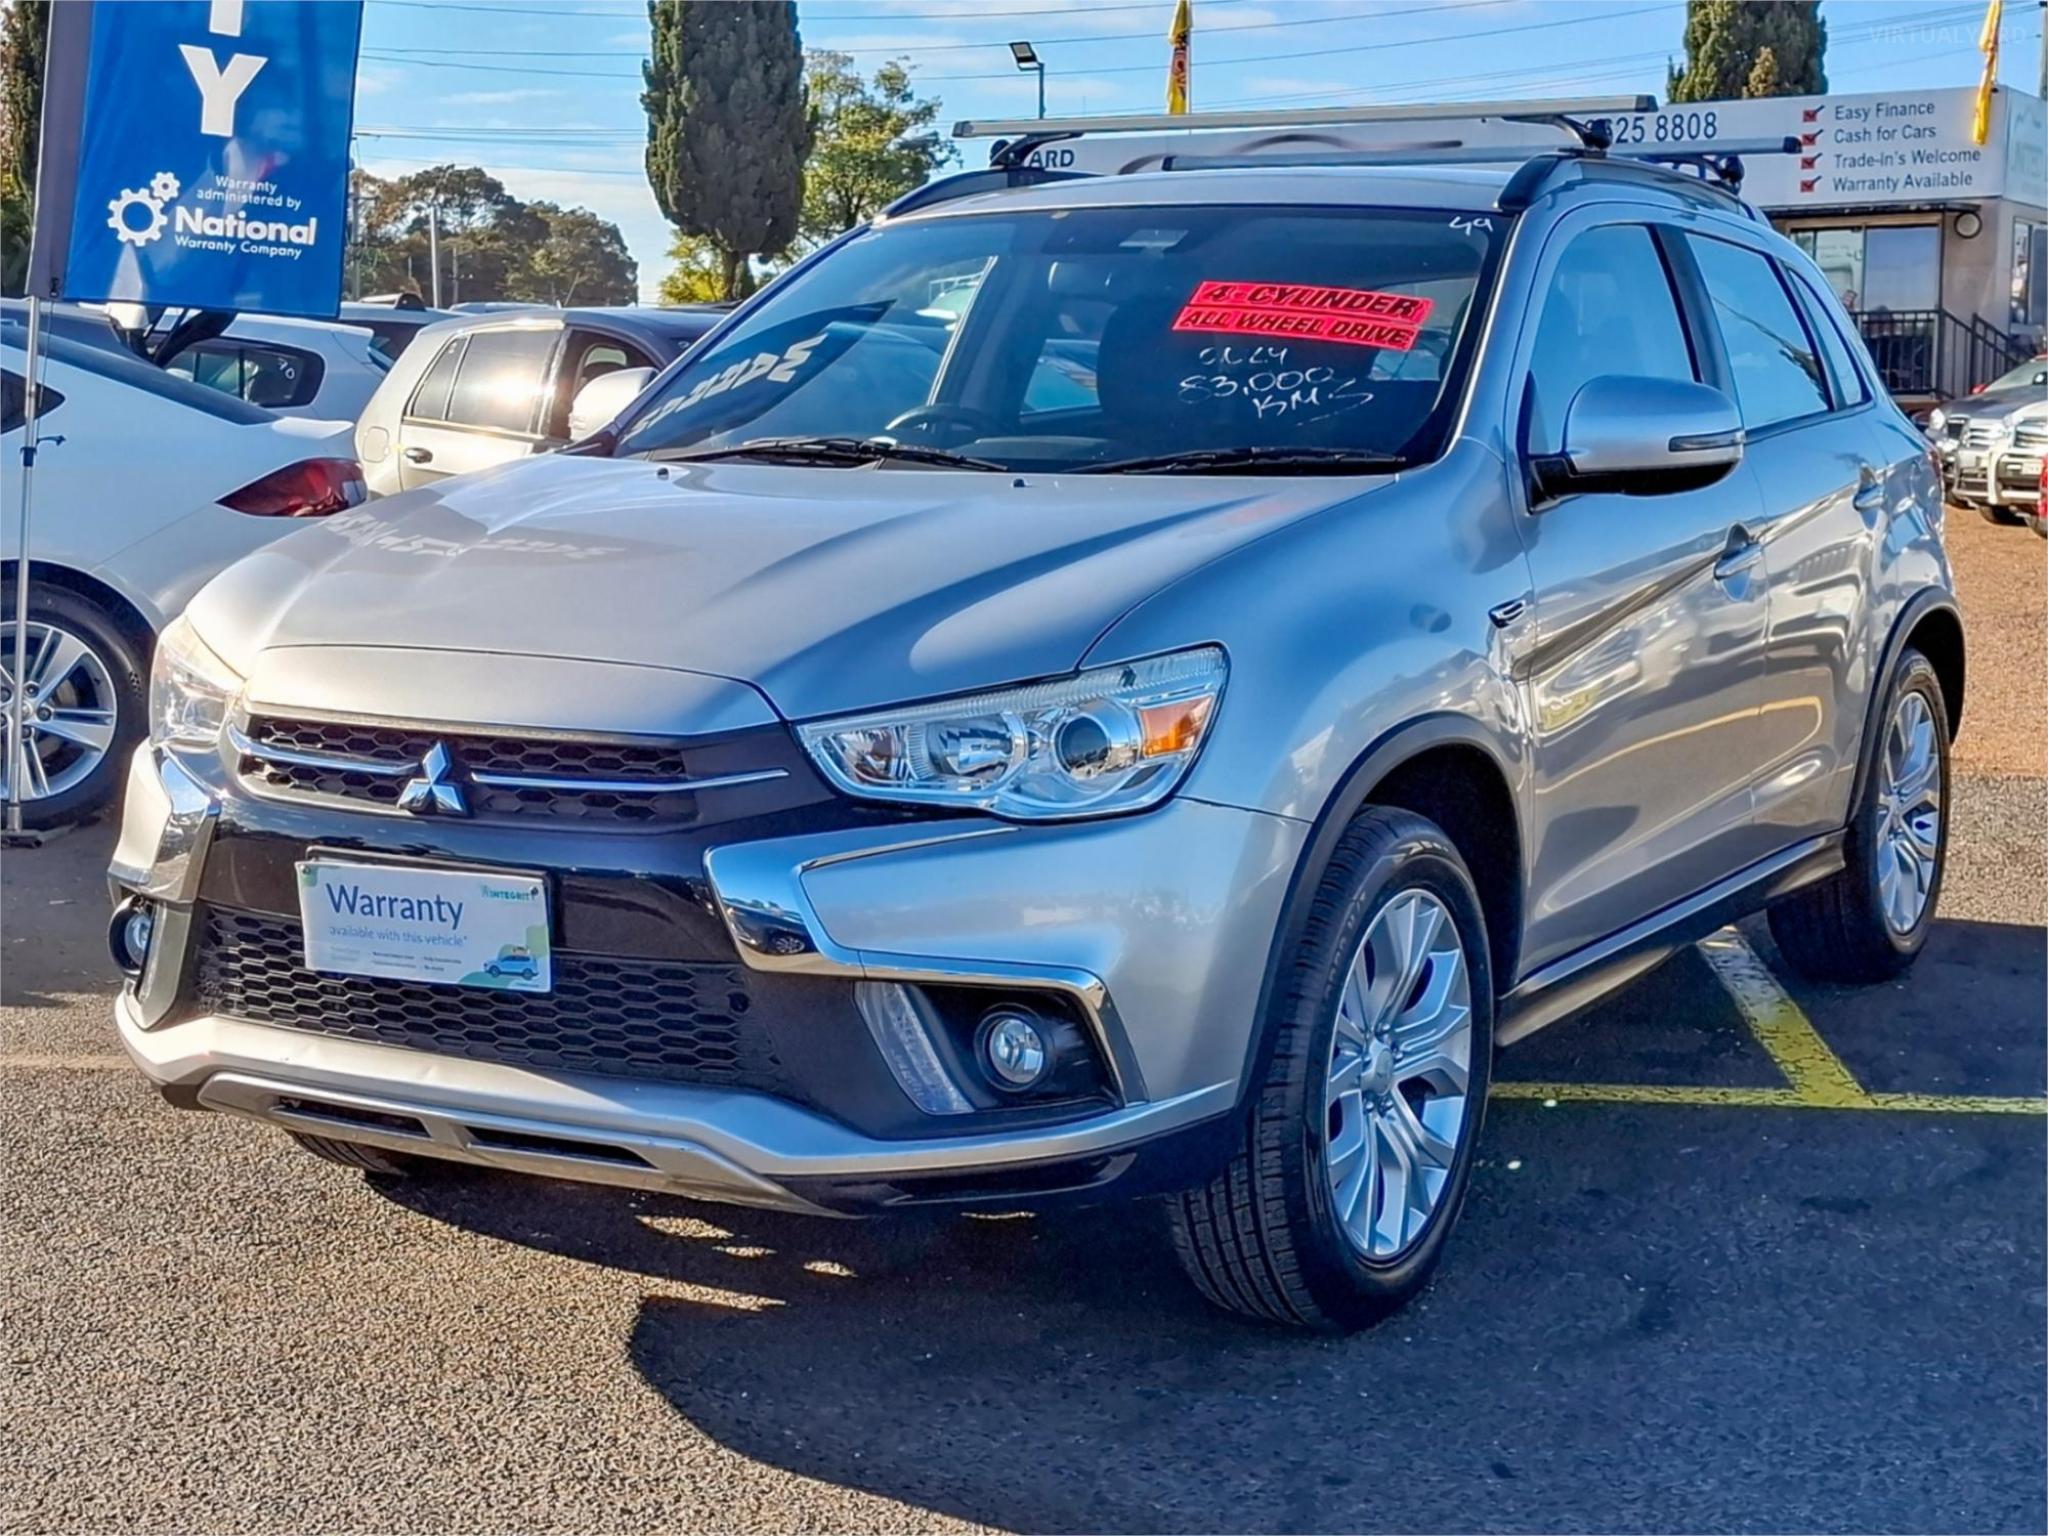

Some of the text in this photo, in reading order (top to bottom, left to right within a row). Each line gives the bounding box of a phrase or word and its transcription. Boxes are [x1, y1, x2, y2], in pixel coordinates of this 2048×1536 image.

[1834, 102, 1936, 122] Easy Finance
[1655, 112, 1717, 142] 8808
[1834, 124, 1936, 143] Cash for Cars
[1911, 149, 1981, 165] Welcome
[215, 175, 278, 195] Warranty
[1833, 171, 1973, 194] Warranty Available
[196, 188, 302, 212] administered by
[175, 205, 317, 245] National
[175, 234, 302, 260] Warranty Company
[1247, 285, 1420, 319] CYLINDER
[1182, 310, 1413, 346] ALL WHEEL DRIVE
[325, 882, 464, 931] Warranty
[329, 925, 374, 940] available
[376, 928, 401, 941] with
[402, 931, 424, 943] this
